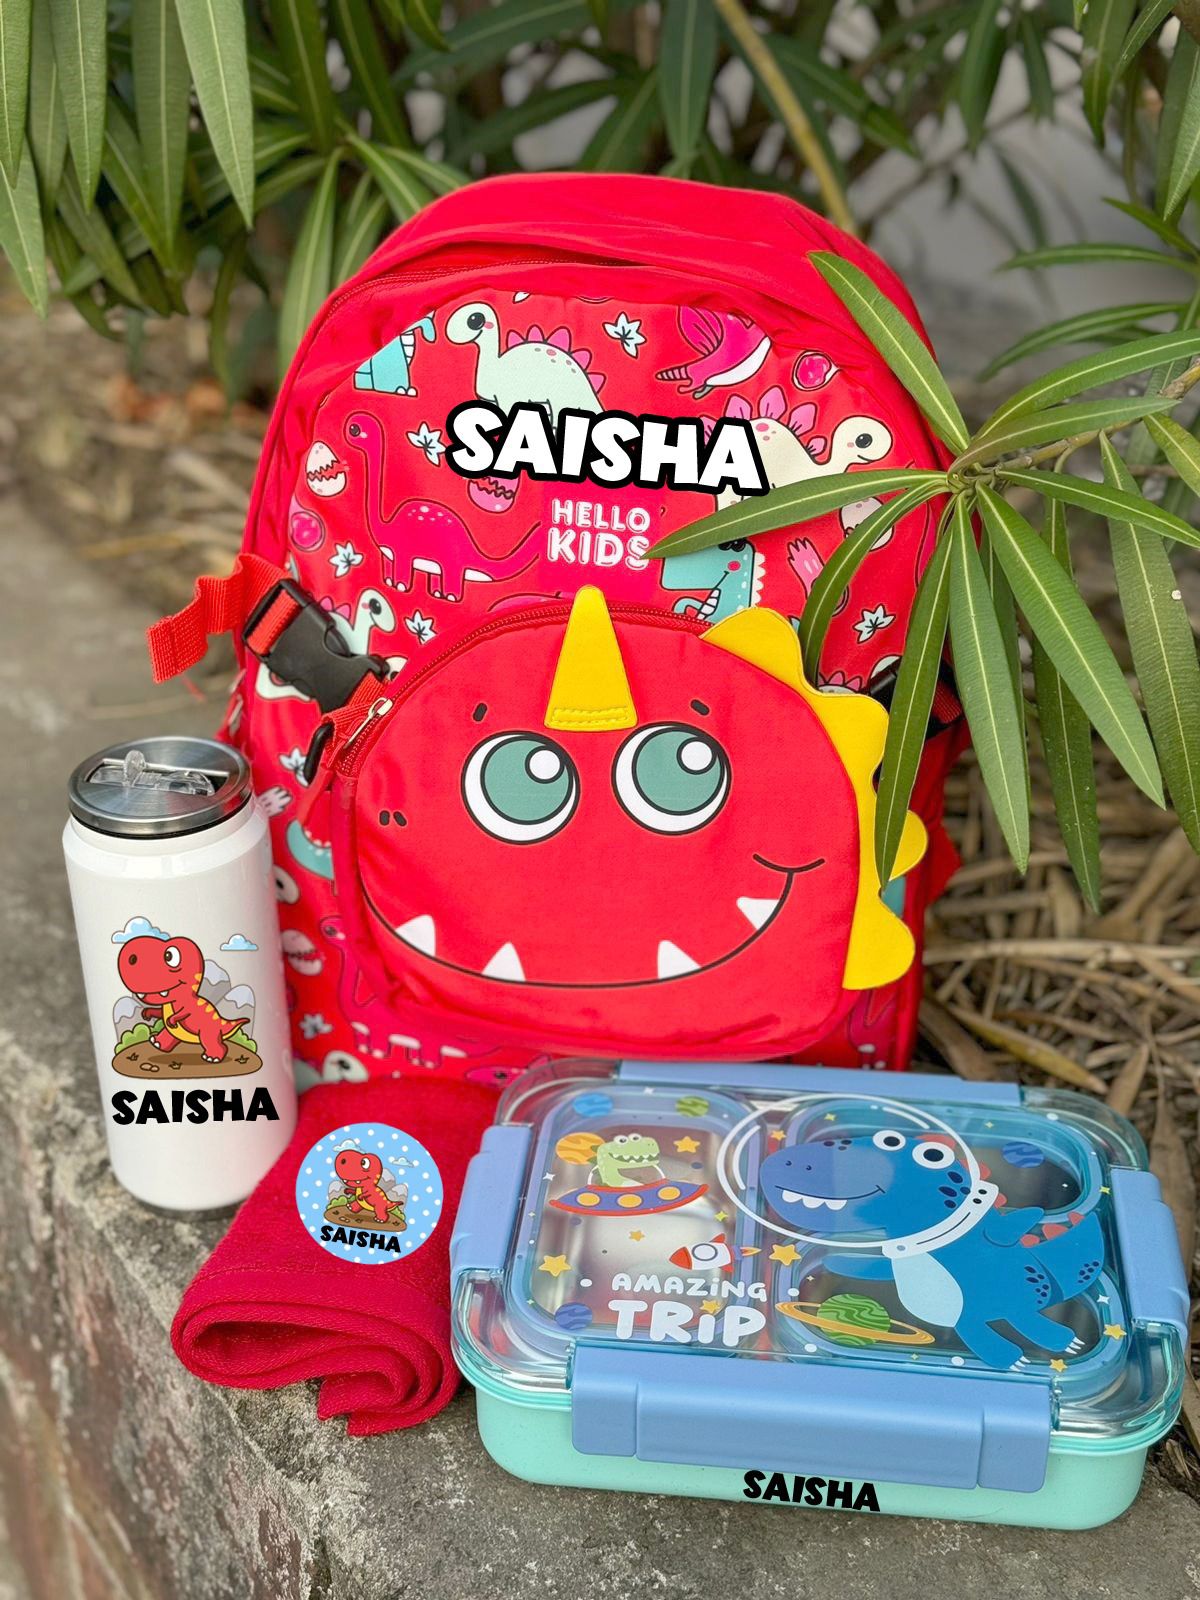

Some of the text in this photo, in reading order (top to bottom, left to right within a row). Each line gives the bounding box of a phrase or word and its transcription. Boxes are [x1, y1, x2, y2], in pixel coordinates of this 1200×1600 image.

[450, 404, 765, 491] SAISHA
[551, 498, 651, 534] HELLO
[547, 527, 651, 571] KIDS
[111, 1086, 280, 1126] SAISHA
[320, 1225, 402, 1254] SAISHA
[743, 1469, 881, 1513] SAISHA
